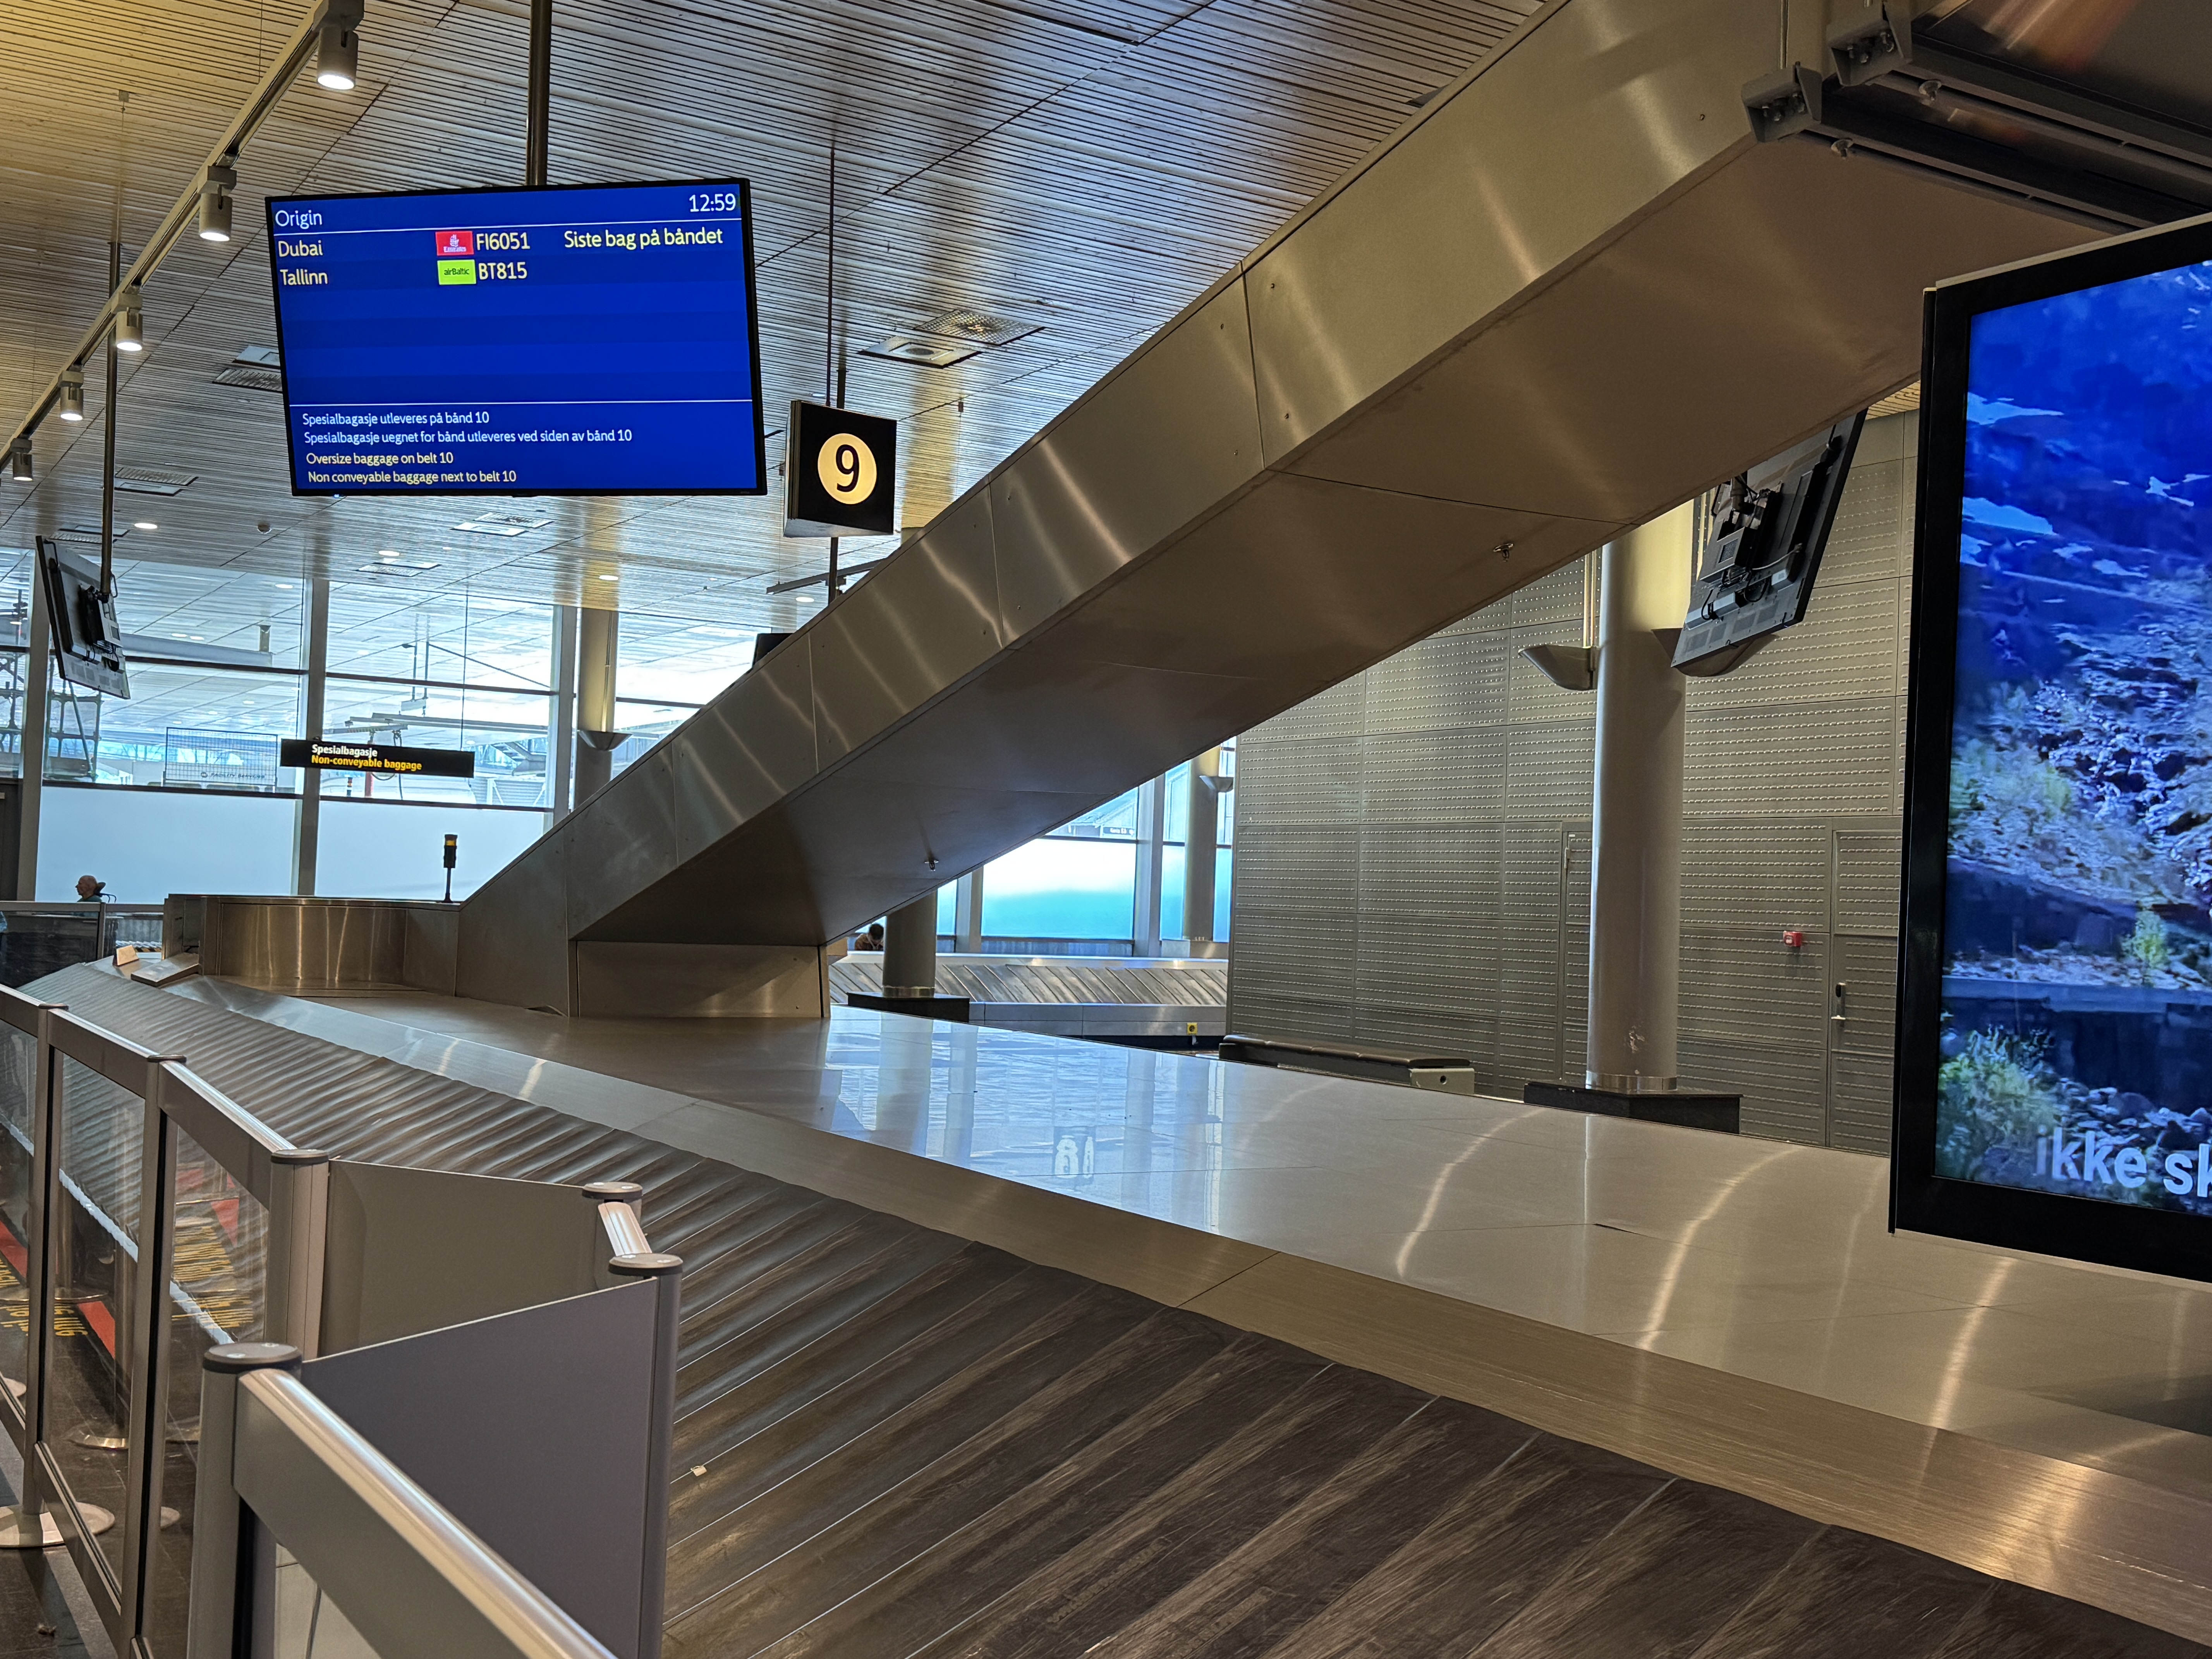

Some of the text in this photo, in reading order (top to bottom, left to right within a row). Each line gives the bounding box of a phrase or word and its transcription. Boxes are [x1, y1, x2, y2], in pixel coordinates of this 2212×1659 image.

[689, 193, 736, 212] 12:59
[276, 210, 322, 229] Origin
[477, 232, 530, 250] FI6051
[565, 227, 723, 250] Siste bag på båndet
[278, 240, 323, 257] Dubai
[280, 269, 327, 285] Tallinn
[479, 262, 527, 280] BT815
[303, 412, 489, 427] Spesialbagasje utleveres på bånd 10
[304, 429, 632, 445] Spesialbagasje uegnet for bånd utleveres ved siden av bånd 10
[306, 453, 351, 464] Oversize
[354, 453, 398, 466] baggage
[417, 452, 437, 463] belt
[440, 452, 453, 463] 10
[836, 444, 859, 492] 9
[309, 471, 516, 484] Non conveyable baggage next to belt 10
[312, 744, 378, 757] Spesialbagasje
[311, 755, 422, 771] Non-conveyable baggage
[2035, 1124, 2147, 1188] ikke
